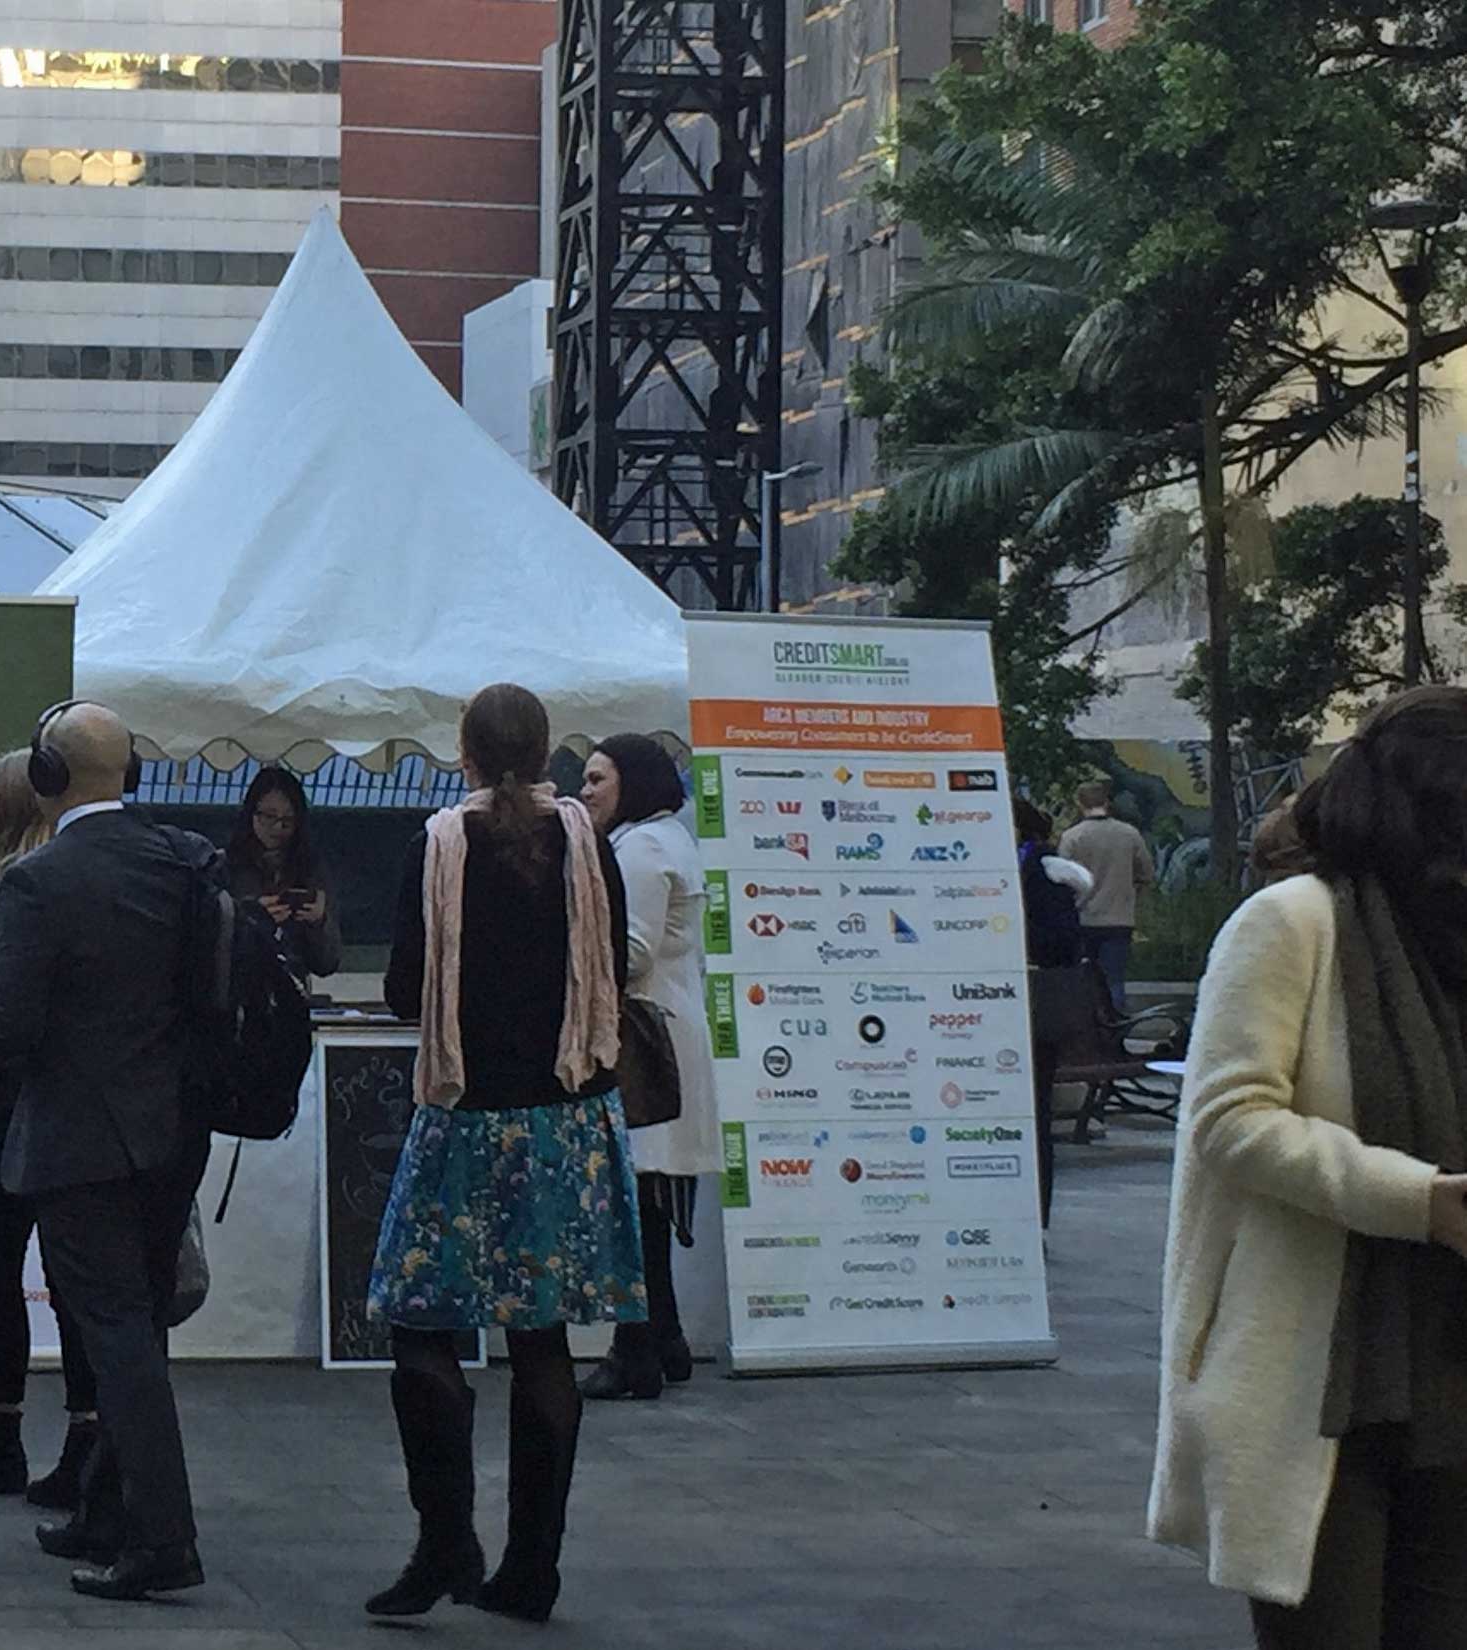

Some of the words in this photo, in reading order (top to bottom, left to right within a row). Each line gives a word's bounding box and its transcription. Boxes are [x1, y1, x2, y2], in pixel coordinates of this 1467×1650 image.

[836, 846, 881, 860] RAMS
[910, 847, 948, 861] ANZ
[952, 982, 1017, 1001] UniBank
[779, 1017, 828, 1036] cua
[929, 1013, 983, 1030] pepper
[945, 1126, 1023, 1144] SocietyOne
[760, 1159, 814, 1176] NOW
[960, 1228, 991, 1245] QBE
